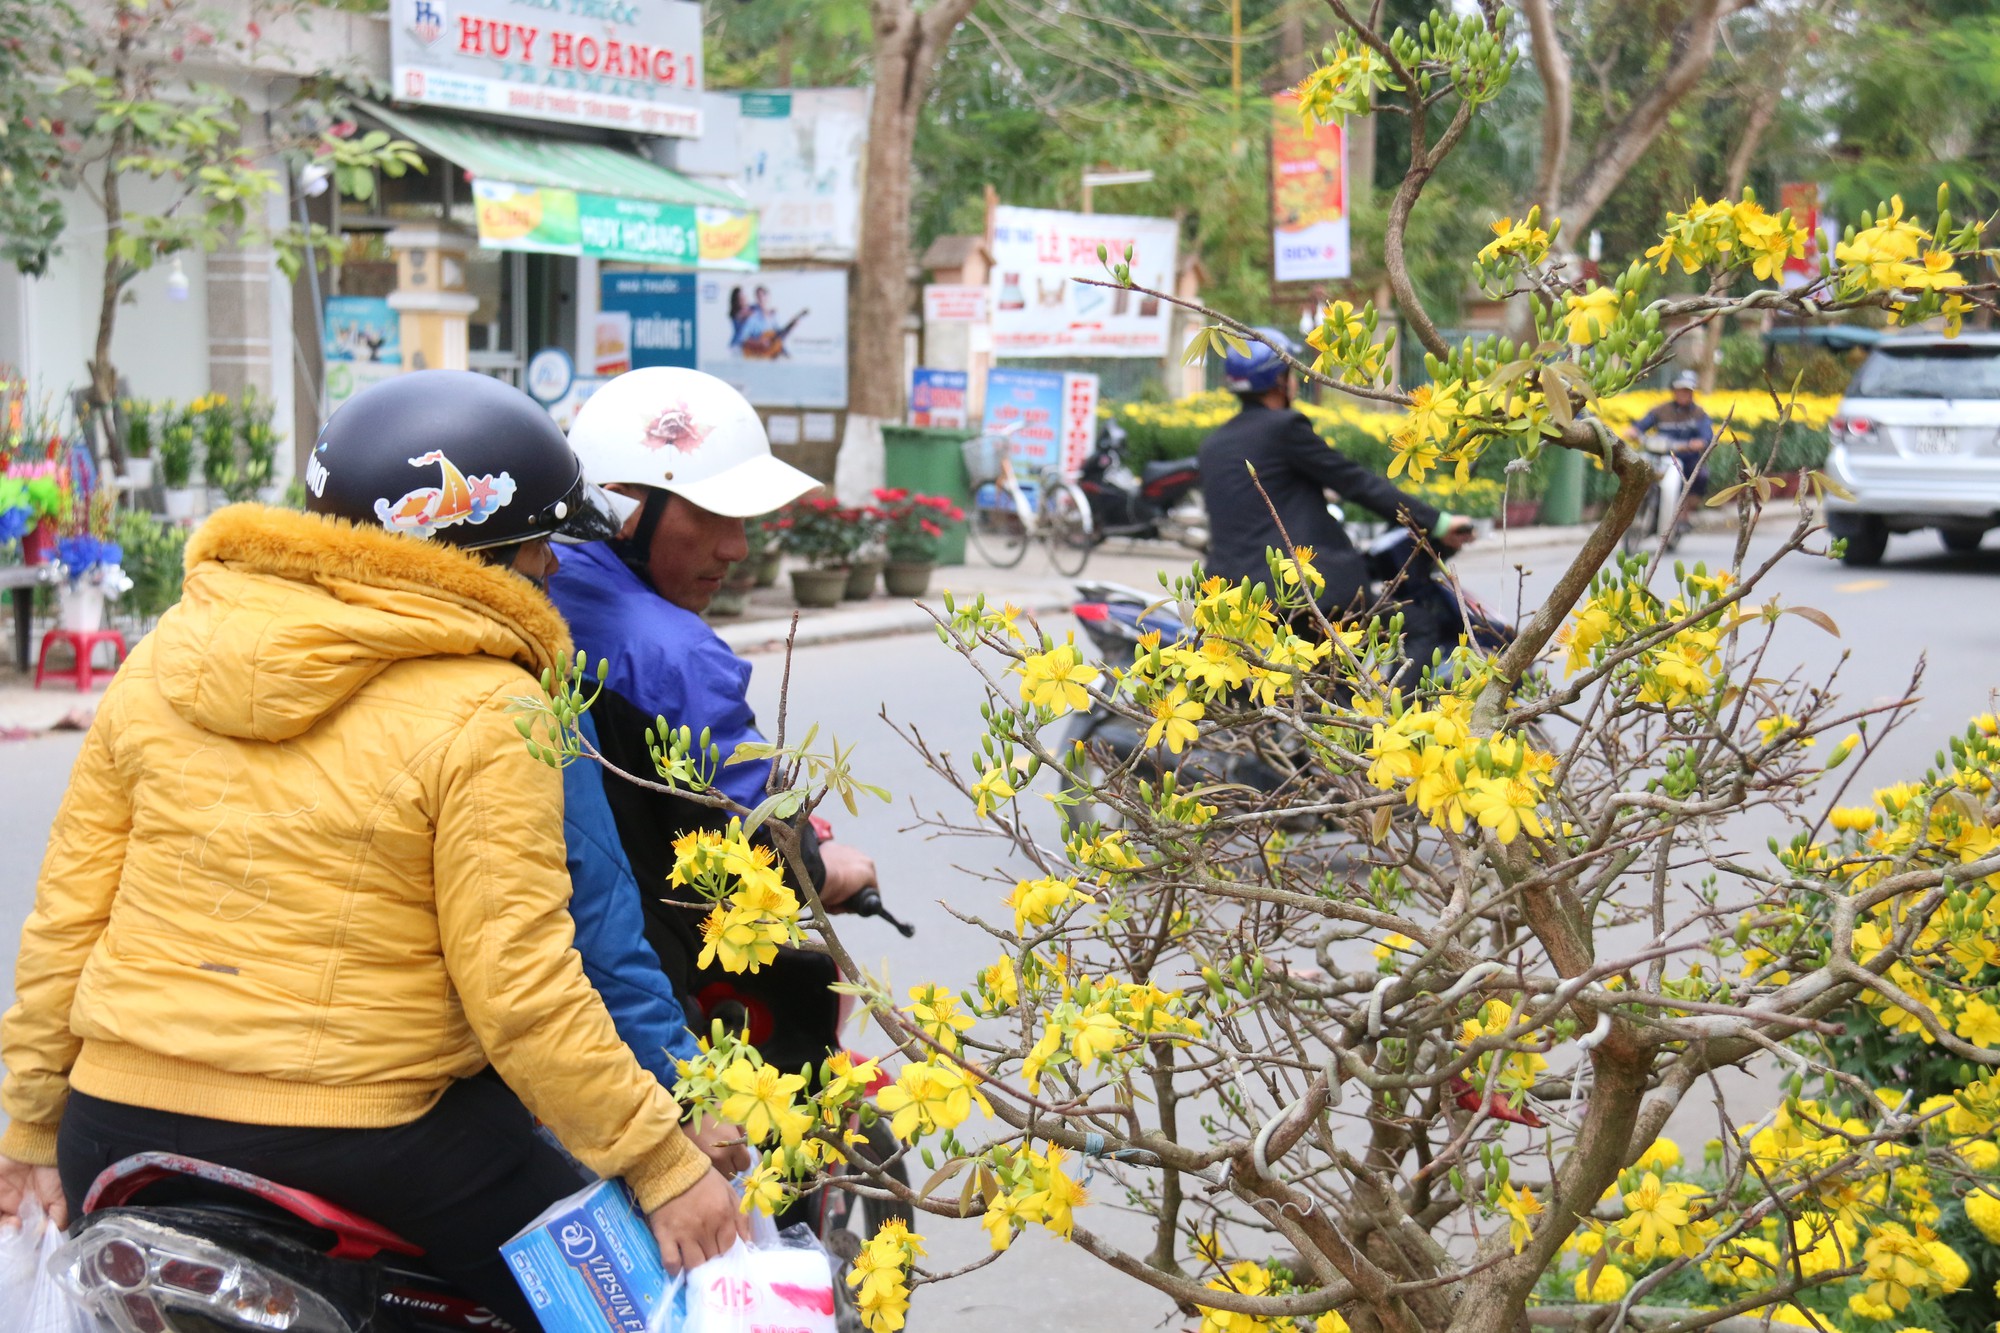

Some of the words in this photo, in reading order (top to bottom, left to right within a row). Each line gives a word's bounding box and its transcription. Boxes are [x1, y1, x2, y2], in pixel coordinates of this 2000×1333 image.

[459, 16, 538, 62] HUY
[551, 26, 677, 84] HOÀNG
[684, 55, 696, 88] 1
[588, 1254, 636, 1317] VIPSUN
